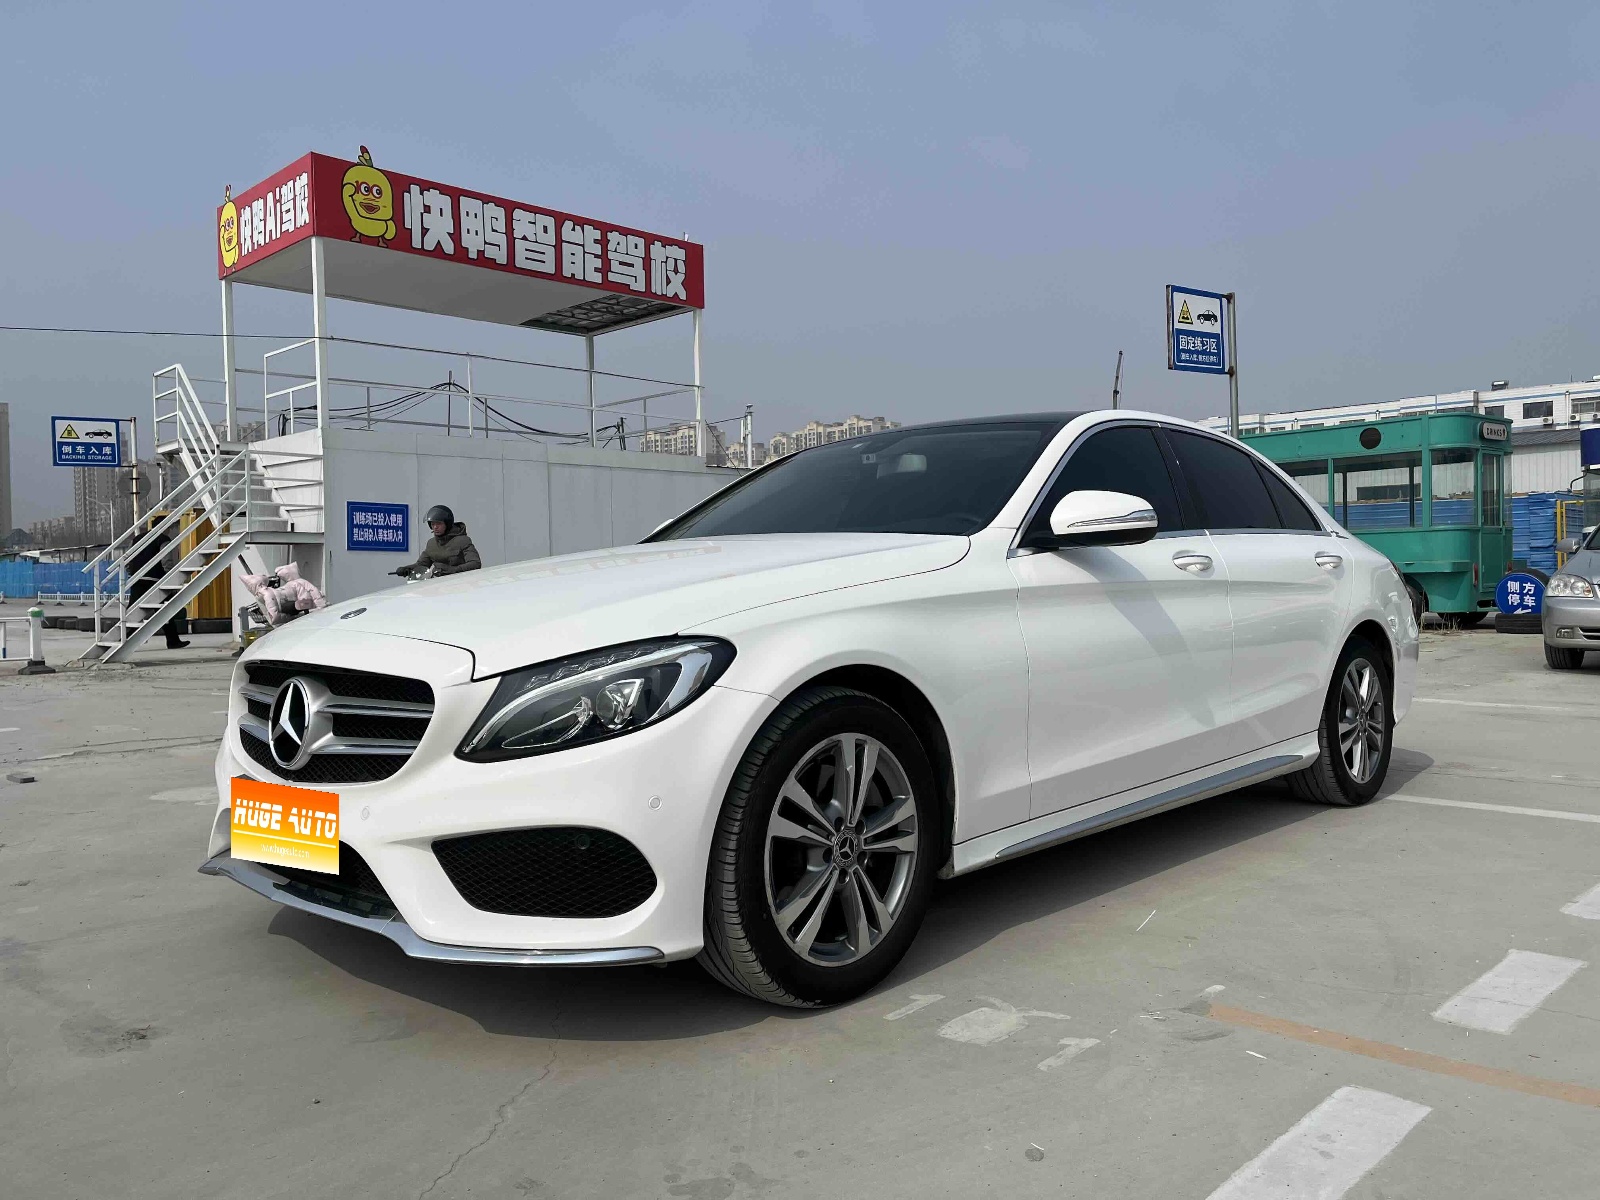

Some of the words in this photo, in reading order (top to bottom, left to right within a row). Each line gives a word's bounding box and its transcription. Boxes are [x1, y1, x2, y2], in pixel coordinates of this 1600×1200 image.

[240, 171, 310, 257] 快鸭Ai驾校
[403, 183, 688, 301] 快鸭智能驾校
[1179, 335, 1218, 353] 固定练习区
[62, 445, 112, 454] 倒车入库
[353, 511, 403, 527] 训练场已投入使用
[1507, 581, 1536, 594] 侧方
[1507, 594, 1536, 607] 停车
